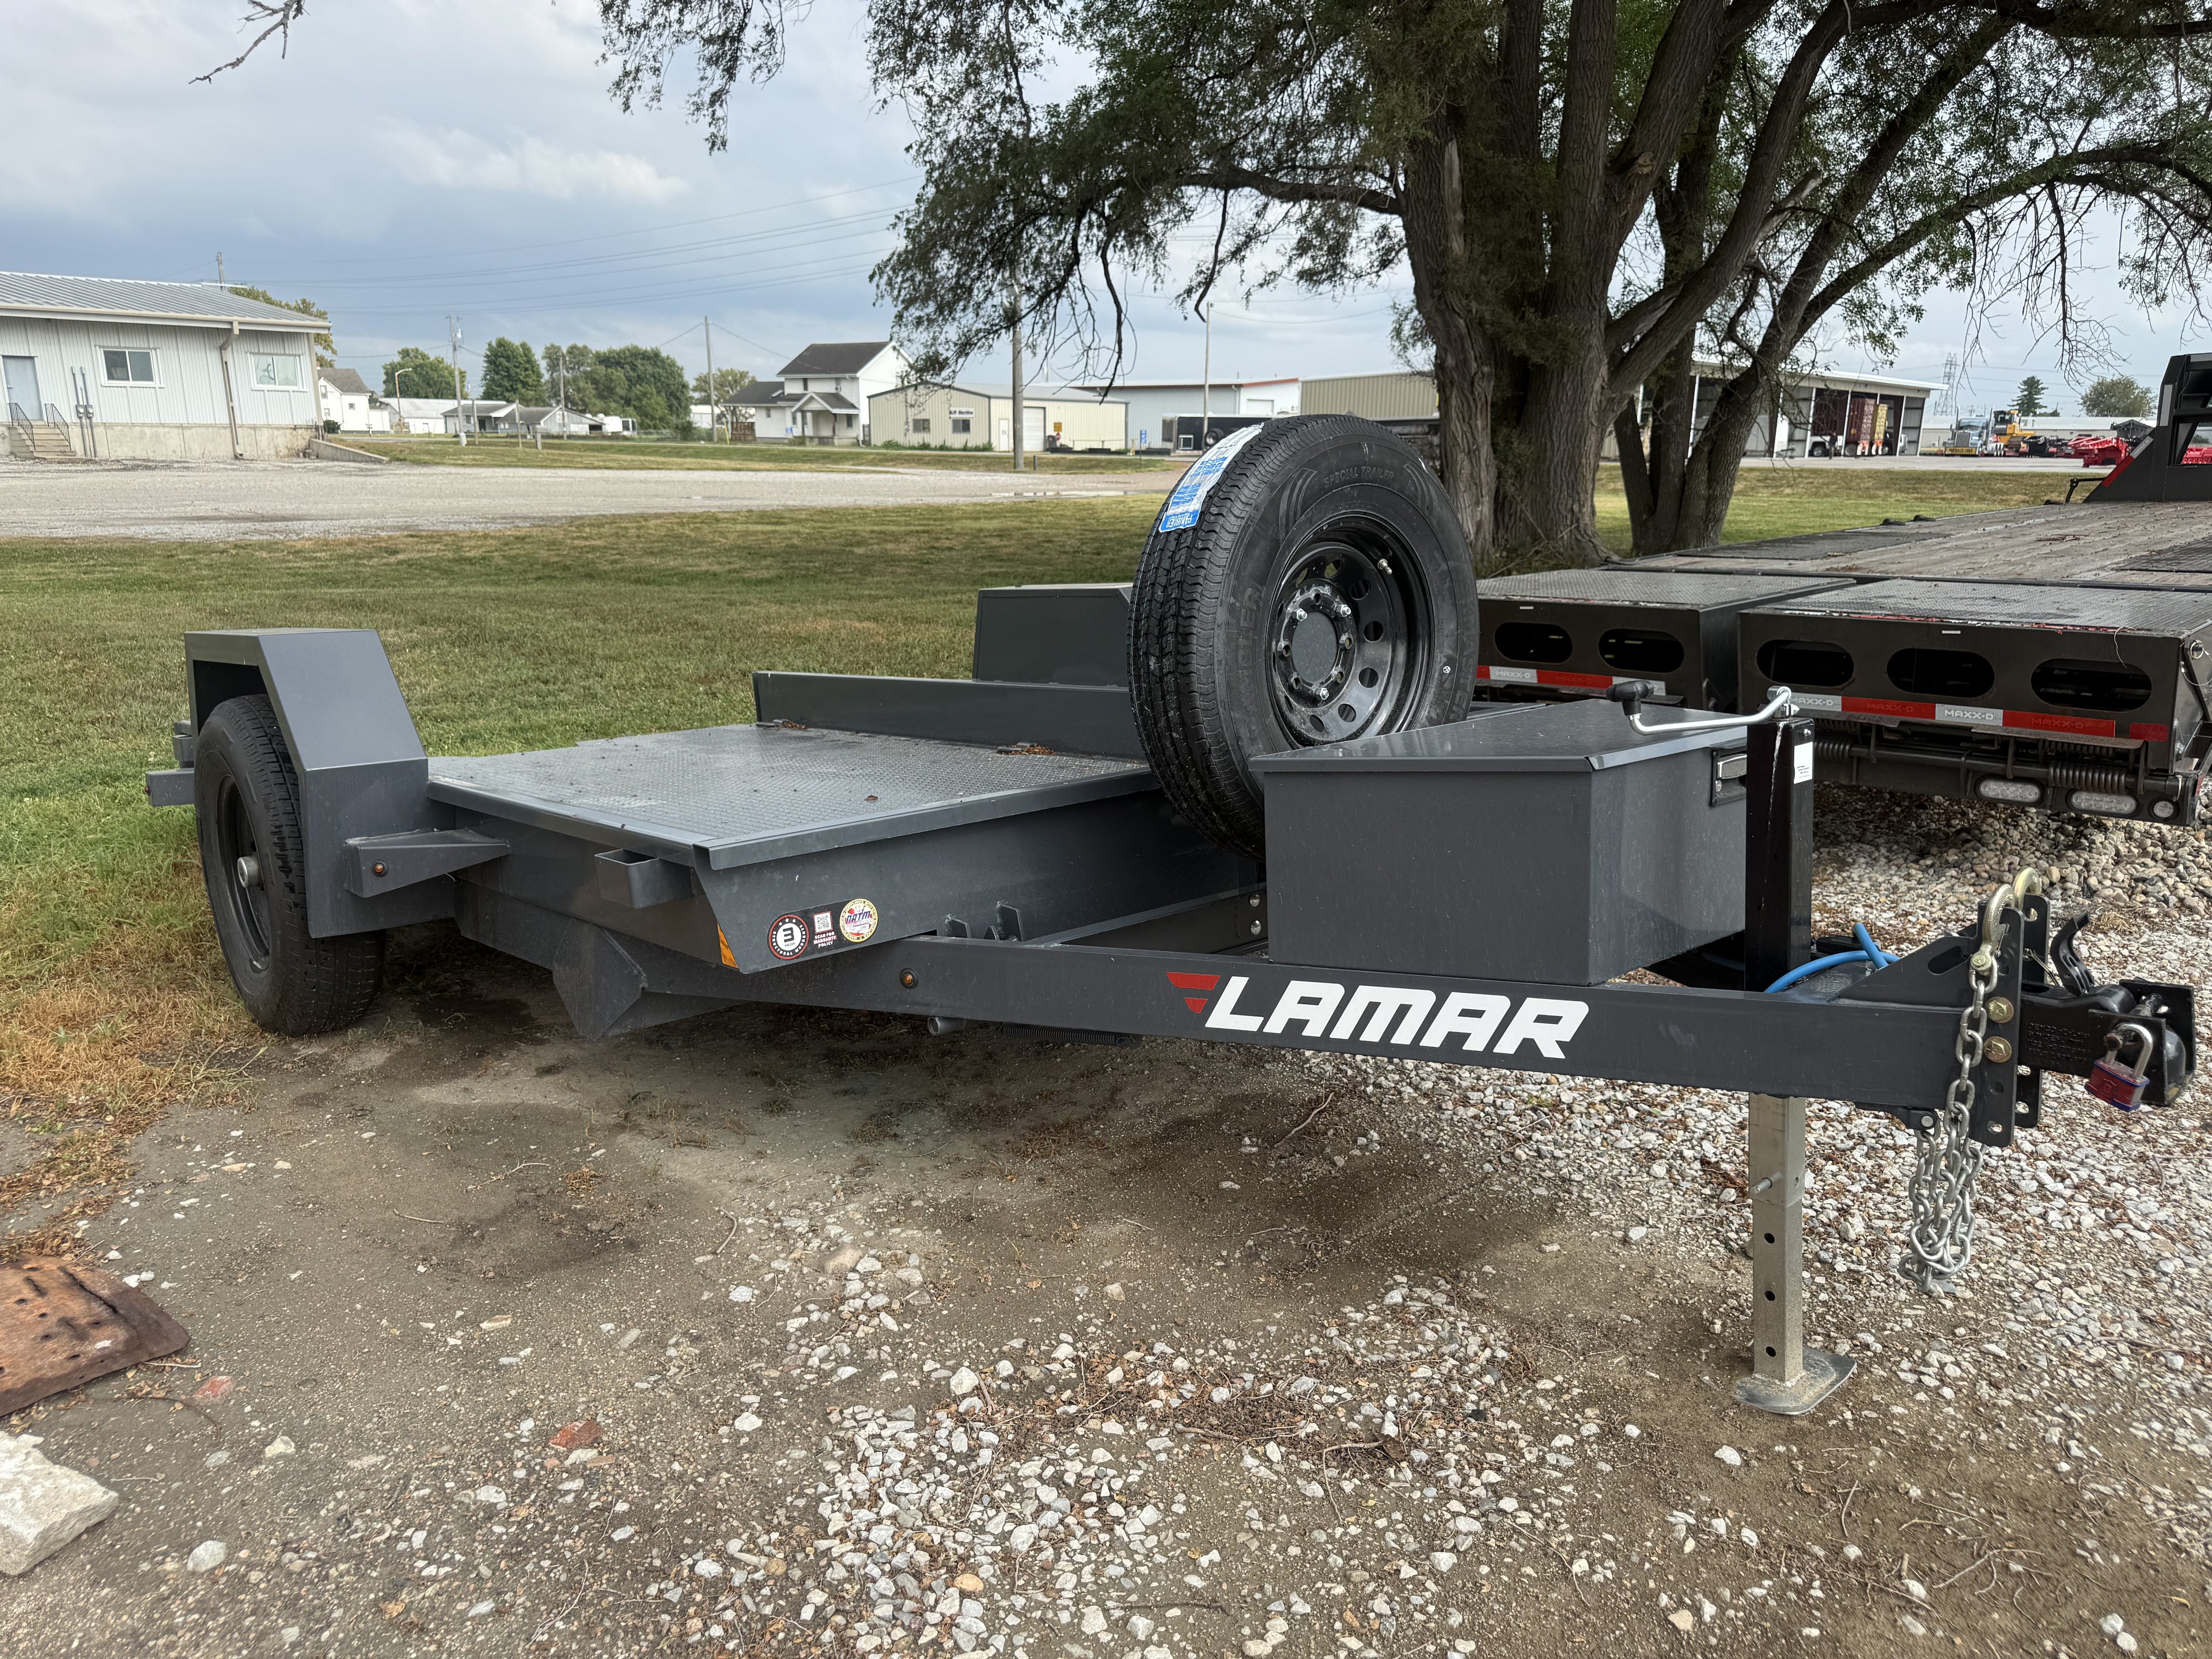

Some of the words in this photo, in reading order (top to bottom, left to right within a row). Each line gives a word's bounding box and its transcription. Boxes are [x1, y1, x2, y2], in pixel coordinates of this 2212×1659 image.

[1323, 467, 1358, 489] SPECIAL
[1361, 466, 1395, 482] TRAILER
[1495, 670, 1531, 679] MAXX-D
[1555, 675, 1592, 684] MAXX-D
[1790, 696, 1834, 706] MAXX-D
[1866, 702, 1914, 712] MAXX-D
[1944, 709, 1994, 720] MAXX-D
[2031, 717, 2084, 729] MAXX-D
[783, 927, 794, 942] 3
[772, 931, 793, 956] STRUCTURAL
[795, 925, 806, 953] WARRANTY
[813, 935, 837, 945] WARRANTY
[818, 941, 834, 949] POLICY
[1205, 975, 1590, 1060] LAMAR
